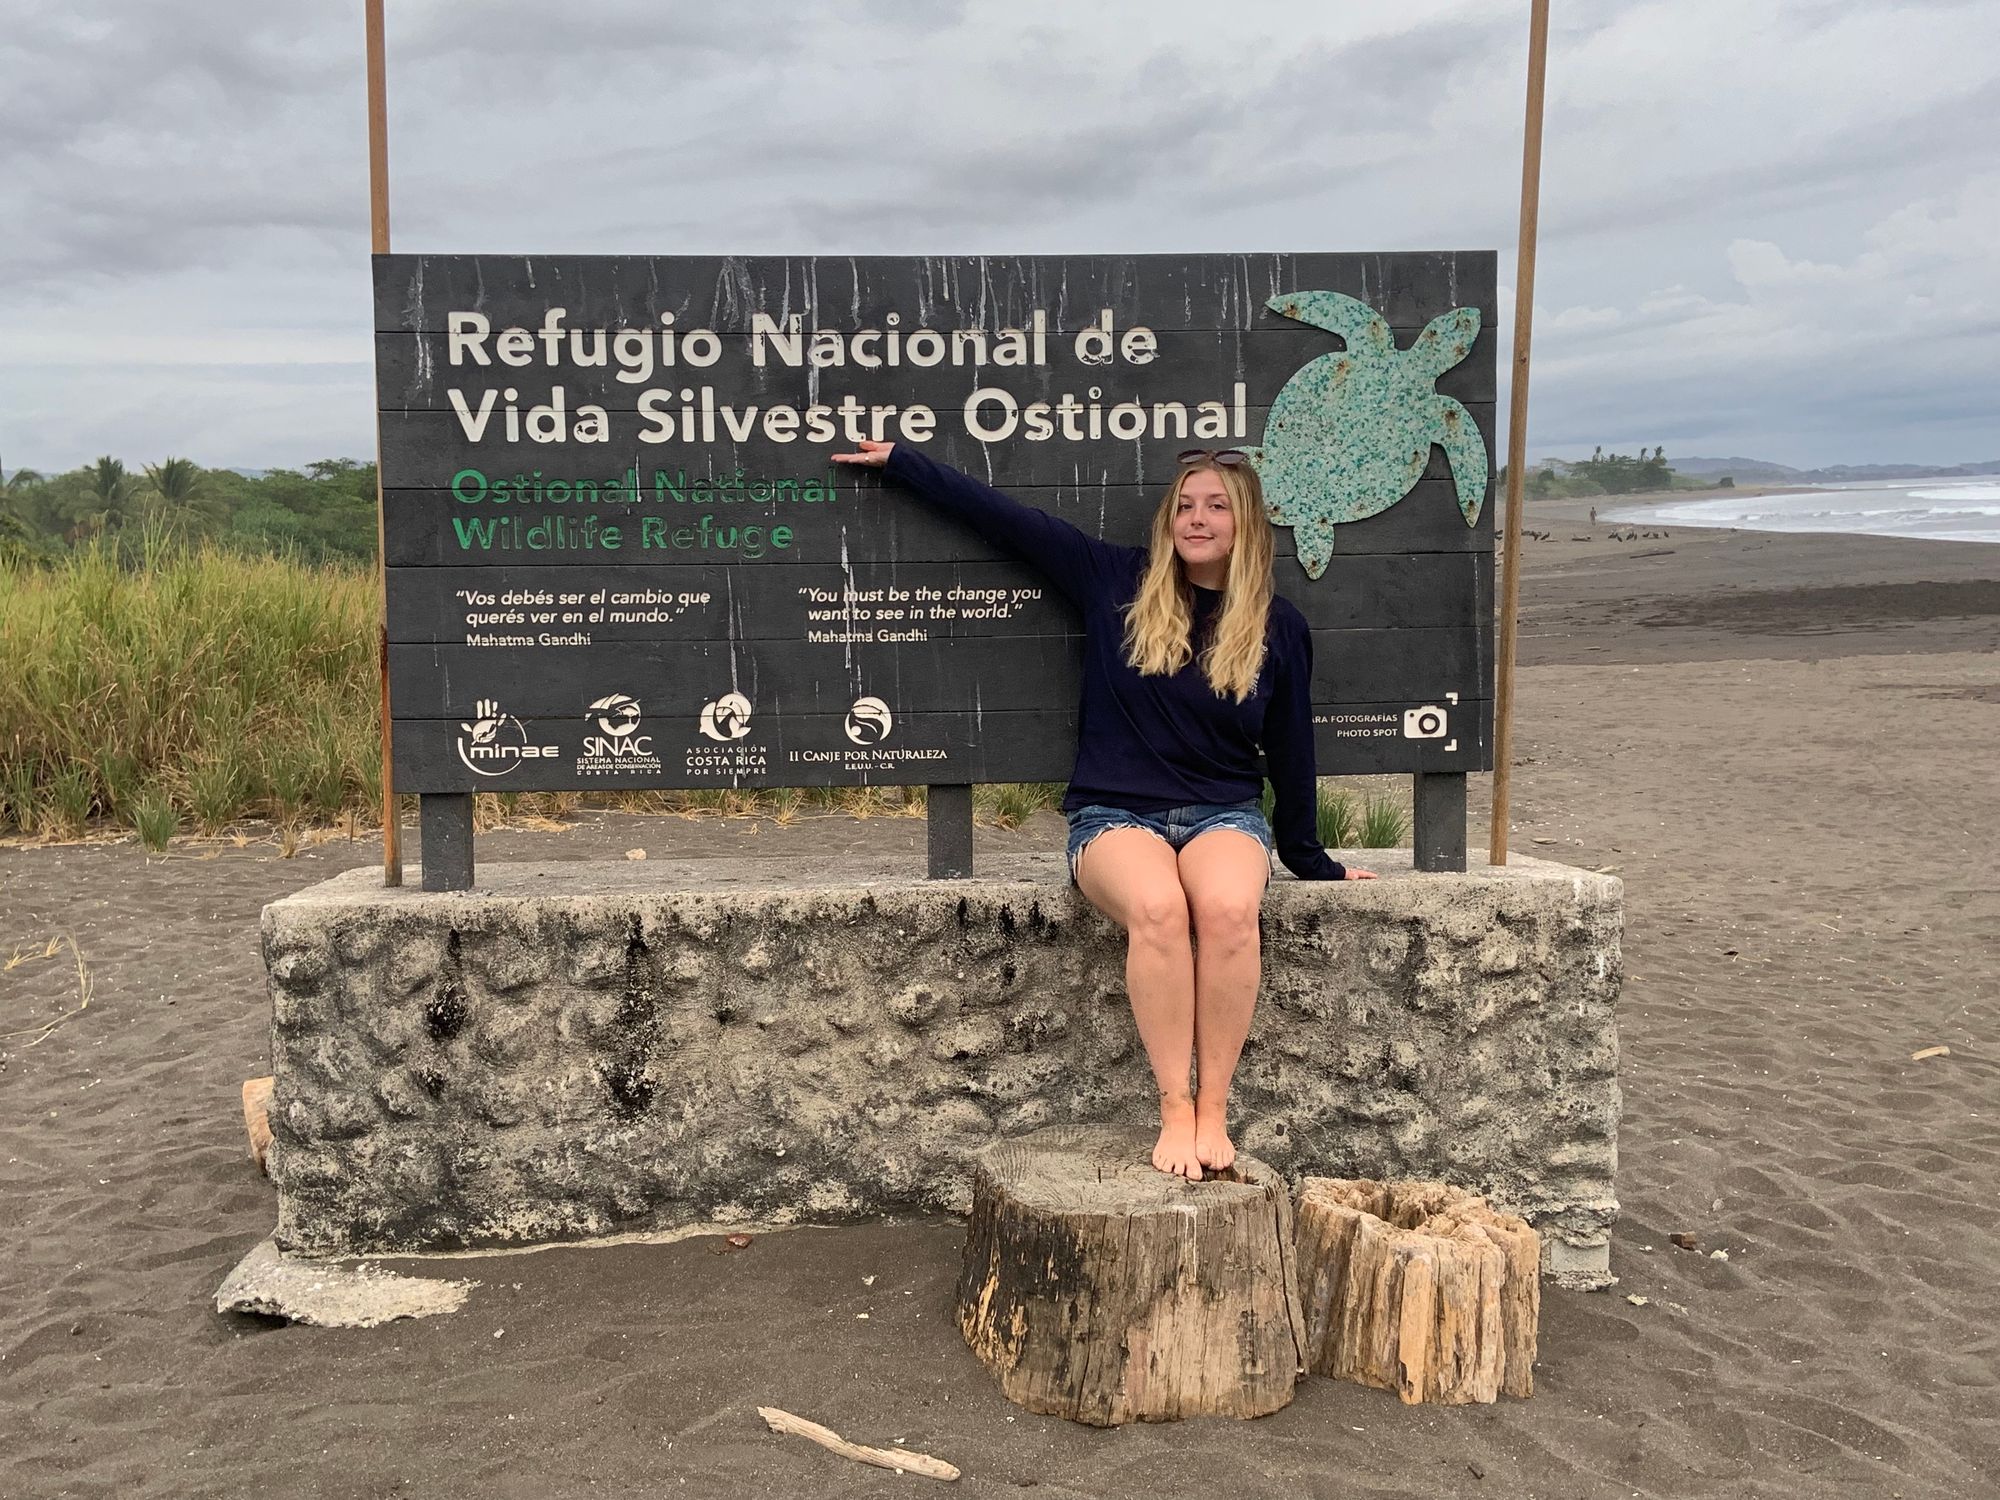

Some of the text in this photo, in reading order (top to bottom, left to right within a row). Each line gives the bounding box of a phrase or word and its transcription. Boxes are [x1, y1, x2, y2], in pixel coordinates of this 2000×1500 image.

[448, 308, 1158, 384] Refugio Nacional de
[447, 382, 1247, 443] Vida Silvestre Ostional
[451, 465, 837, 504] Ostional National
[452, 514, 794, 559] Wildlife Refuge
[456, 588, 711, 607] “Vos debés ser el cambio que
[798, 585, 1042, 604] “You must be the change you
[466, 608, 525, 628] querés
[530, 612, 557, 623] ver
[562, 612, 583, 623] en
[589, 608, 604, 622] el
[808, 607, 849, 620] want
[852, 607, 871, 620] to
[876, 608, 905, 620] see
[909, 605, 924, 619] in
[930, 604, 956, 619] the
[467, 632, 591, 647] Mahatma Gandhi
[808, 628, 928, 643] Mahatma Gandhi
[1331, 713, 1398, 723] FOTOGRAFÍAS
[1337, 728, 1398, 737] PHOTO SPOT
[470, 743, 560, 759] minae
[583, 736, 653, 756] SINAC
[686, 744, 767, 754] ASOCIACIÓN
[686, 755, 767, 766] COSTA RICA
[803, 751, 841, 763] CANJE
[844, 751, 869, 761] POR
[872, 749, 948, 761] NATURALEZA
[716, 767, 767, 775] SIEMPRE
